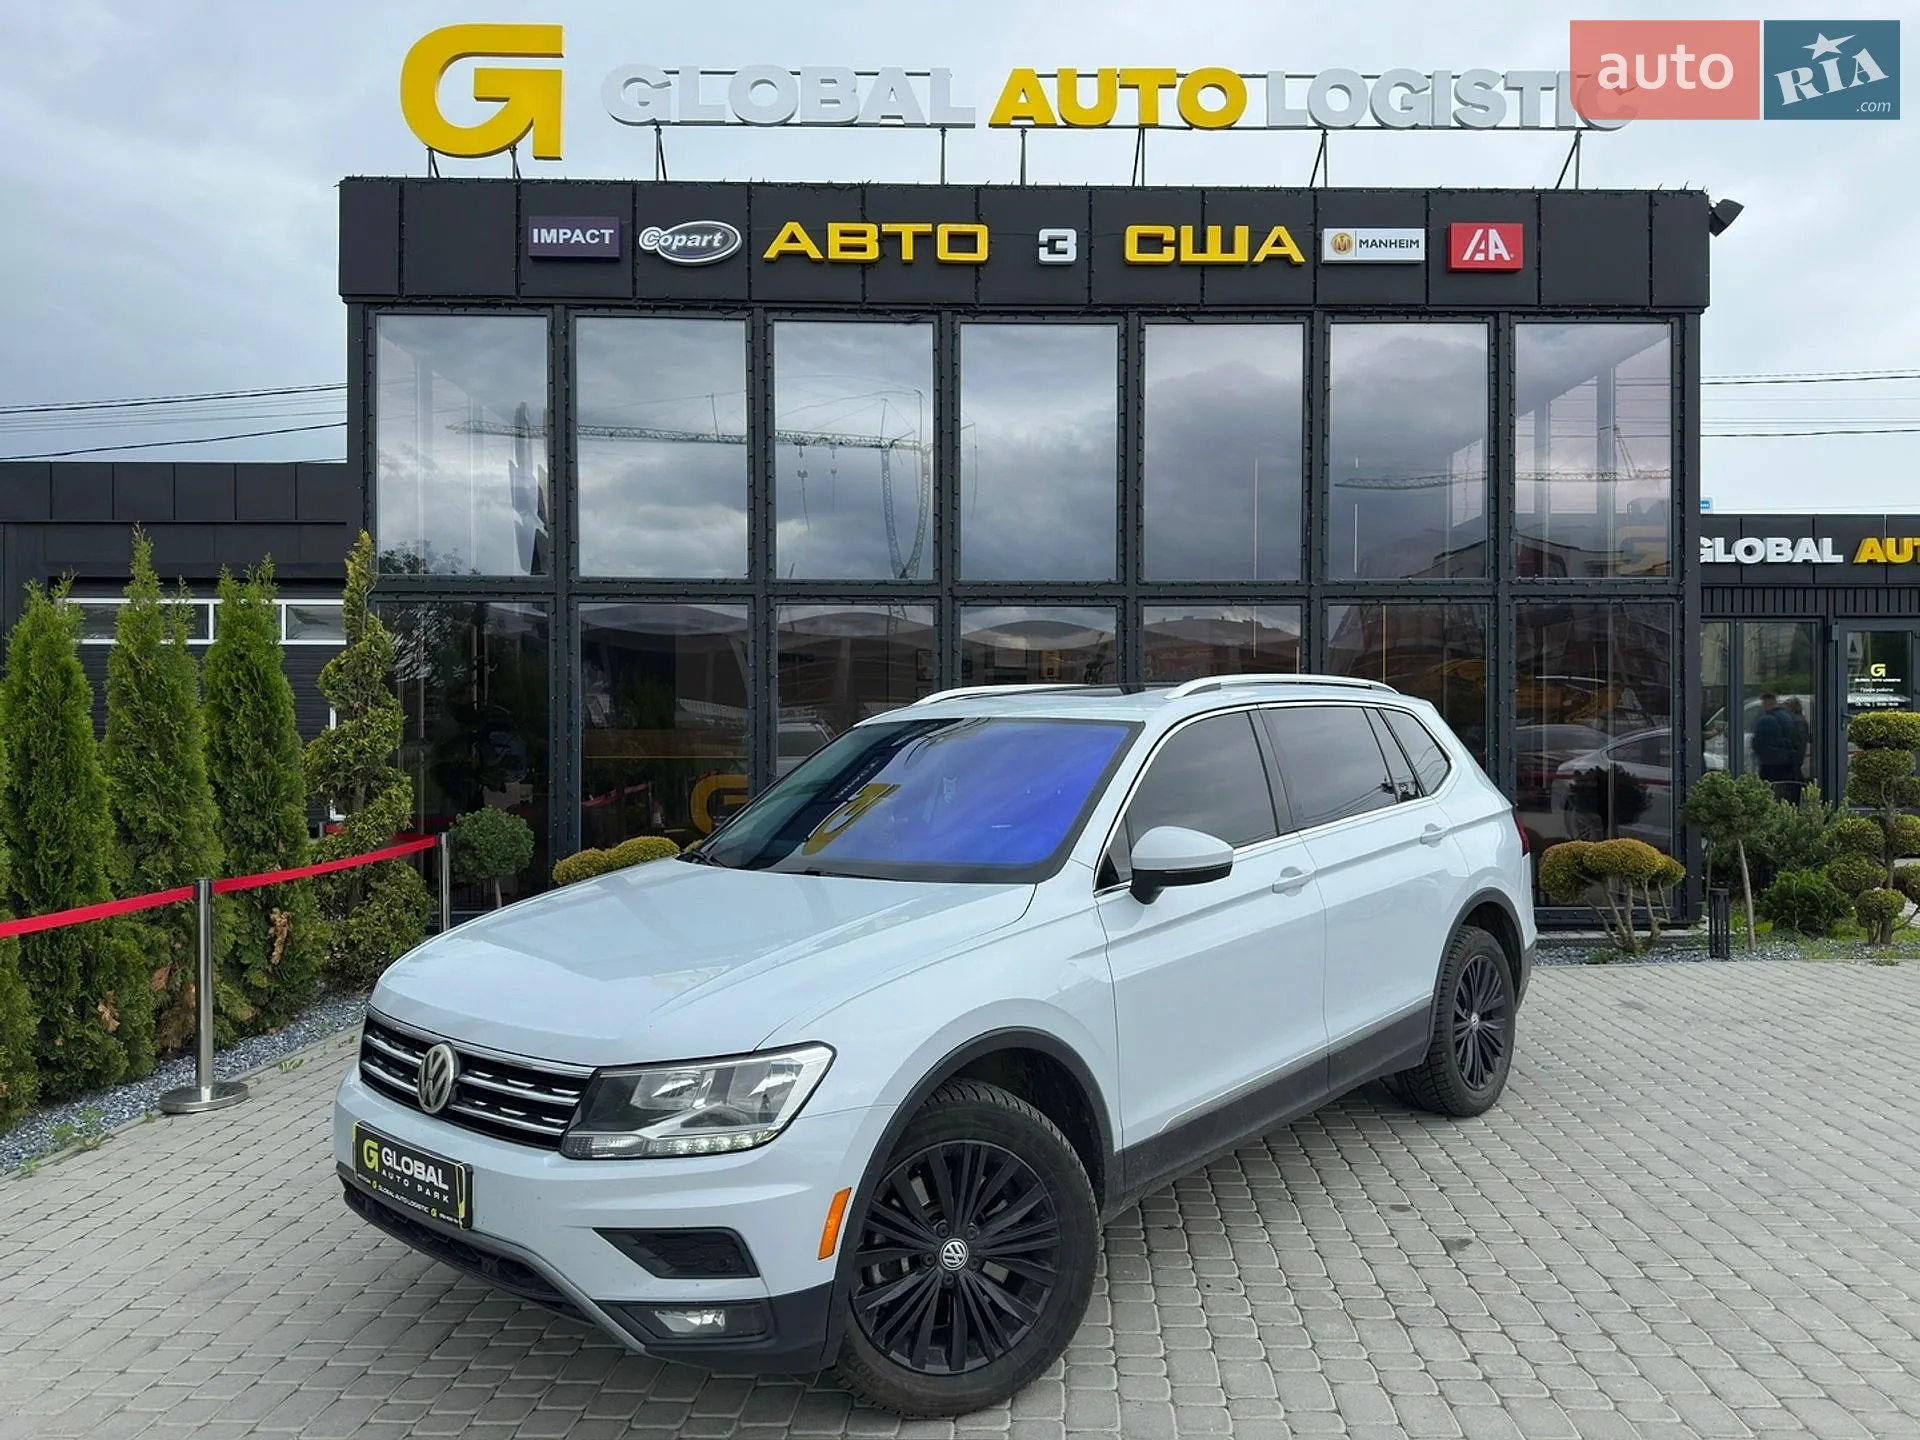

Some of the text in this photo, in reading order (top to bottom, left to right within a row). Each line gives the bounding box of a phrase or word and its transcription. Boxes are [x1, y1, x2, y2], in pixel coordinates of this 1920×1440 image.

[601, 63, 1638, 131] GLOBAL AUTO LOGISTIC
[532, 227, 615, 245] IMPACT
[641, 229, 725, 251] Copart
[762, 221, 990, 265] АВТО
[1124, 224, 1306, 266] США
[1358, 238, 1420, 249] MANHEIM
[381, 1146, 450, 1191] GLOBAL
[381, 1168, 411, 1188] AUTO
[417, 1183, 450, 1205] PARK
